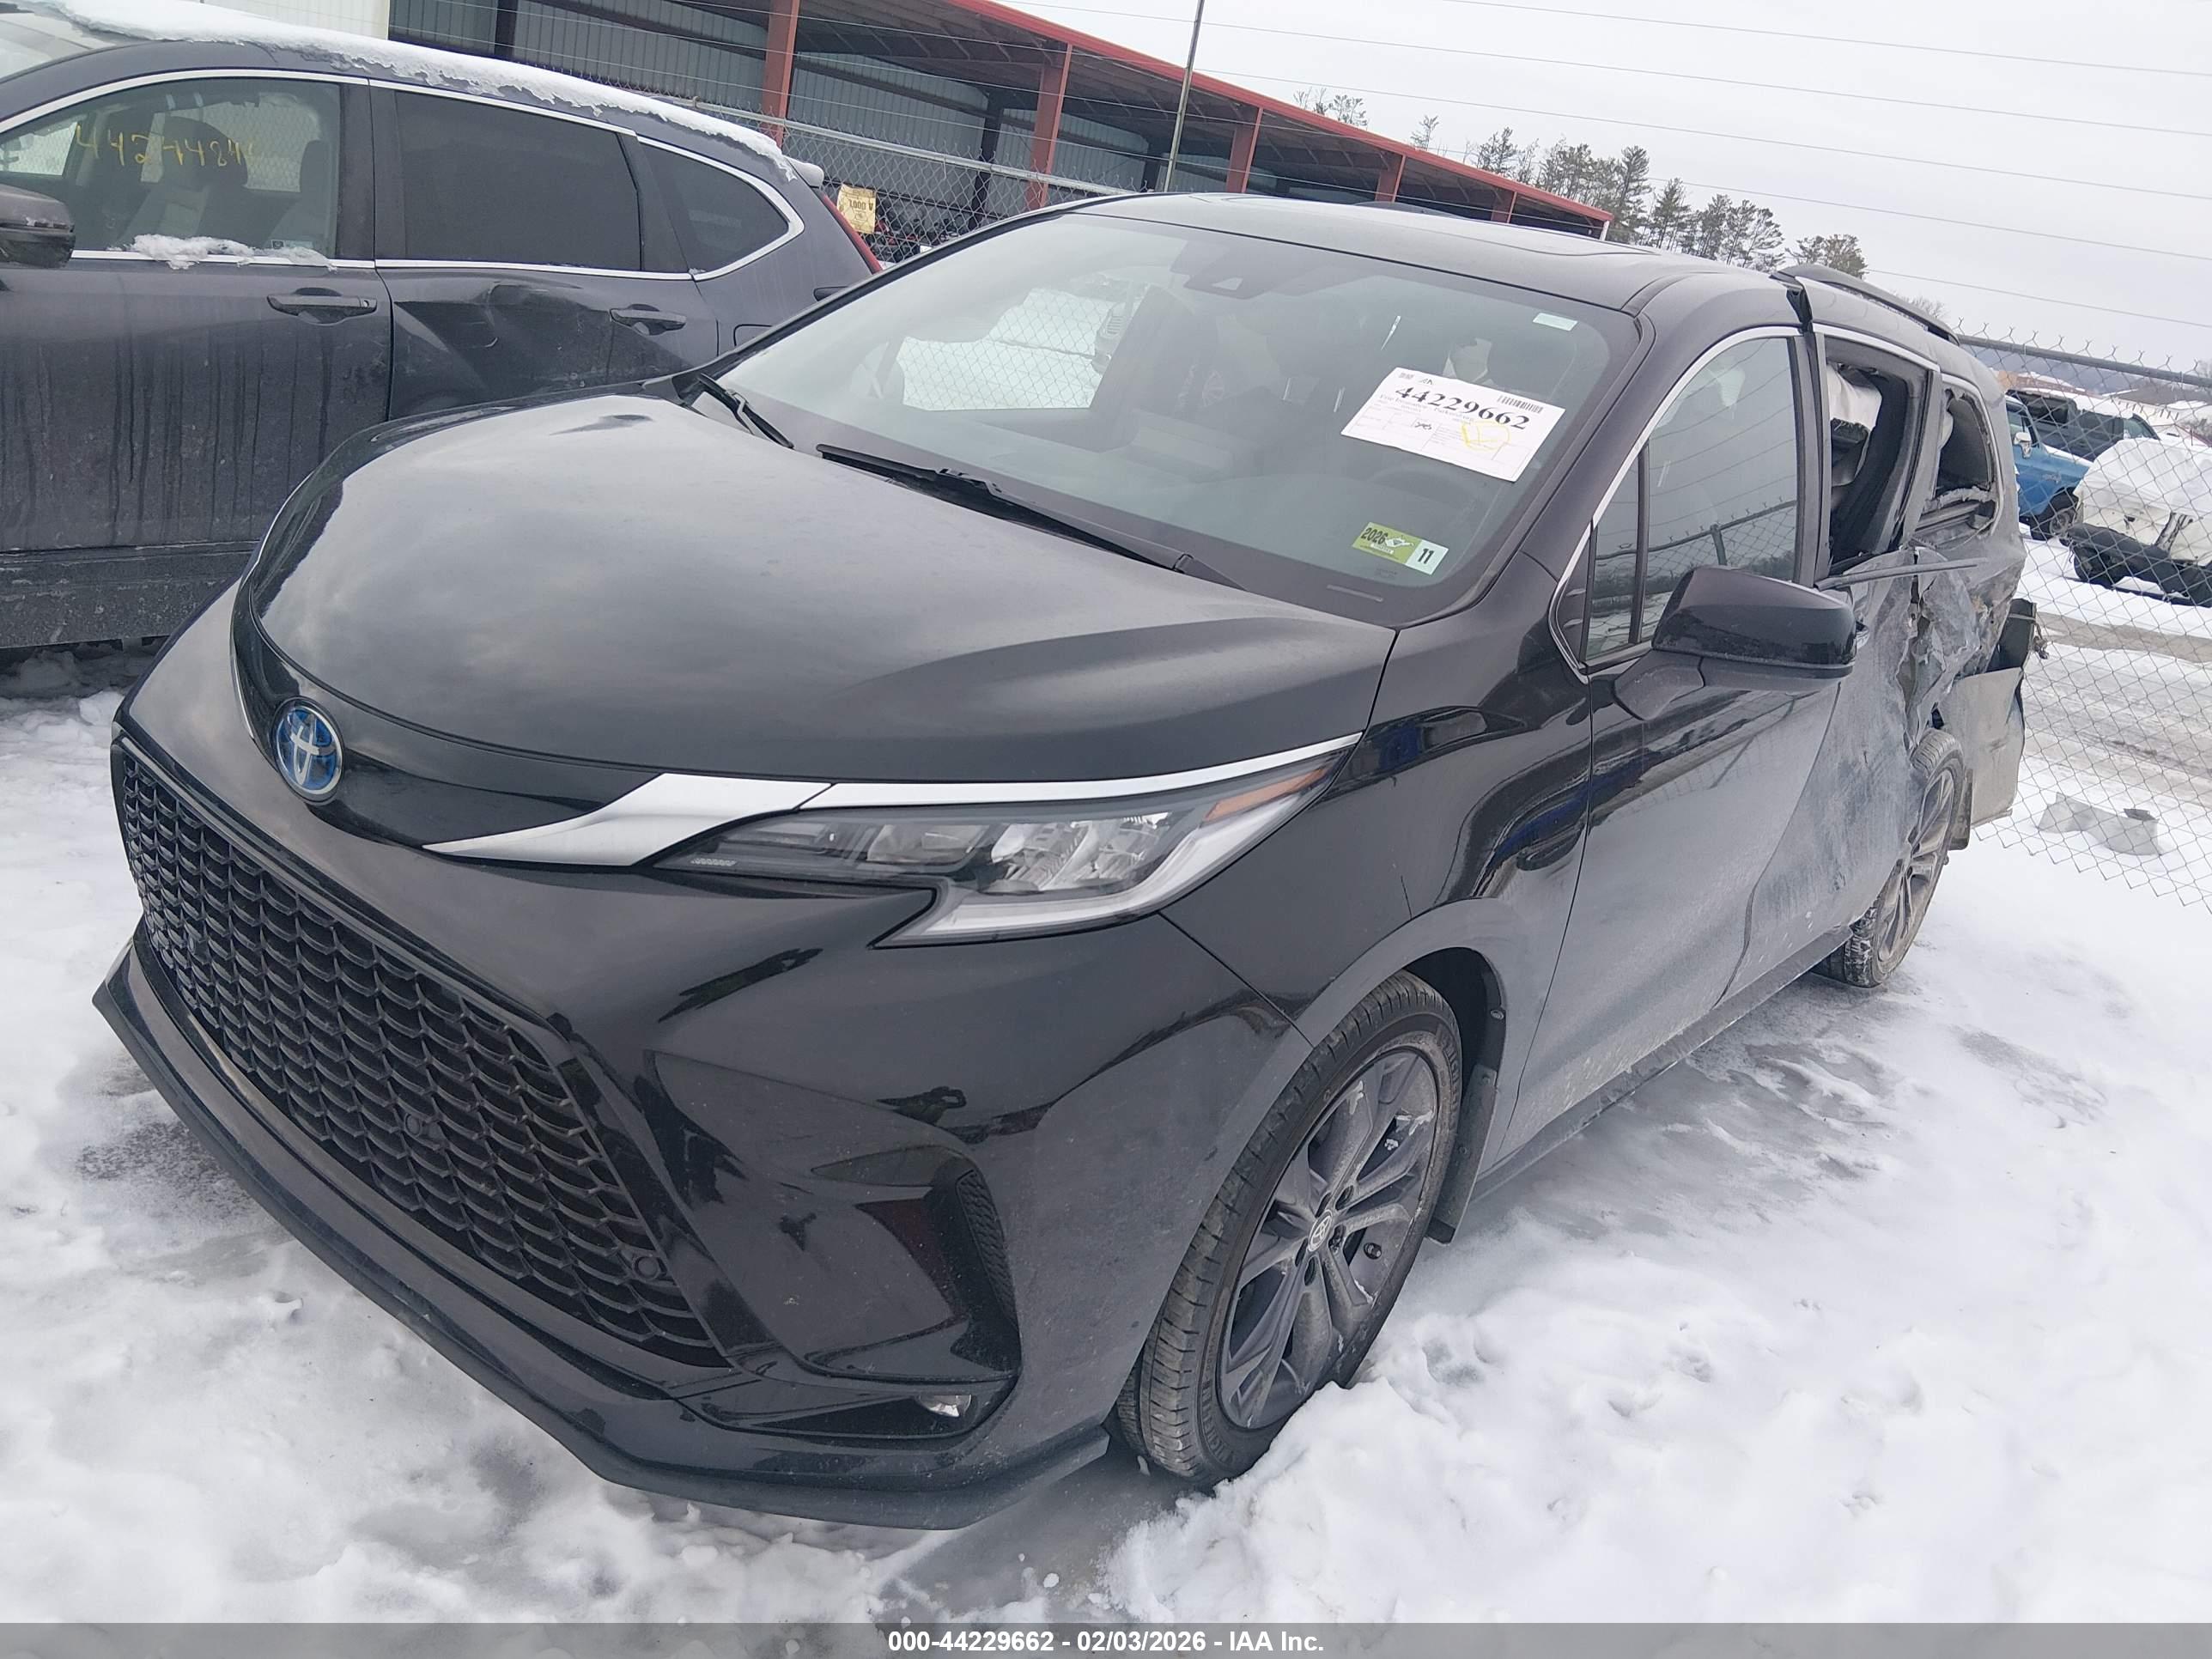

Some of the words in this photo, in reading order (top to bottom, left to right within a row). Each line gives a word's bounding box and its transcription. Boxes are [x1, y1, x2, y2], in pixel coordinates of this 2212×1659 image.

[1395, 386, 1532, 431] 44229662
[1360, 527, 1389, 545] 2026
[1418, 548, 1435, 564] 11
